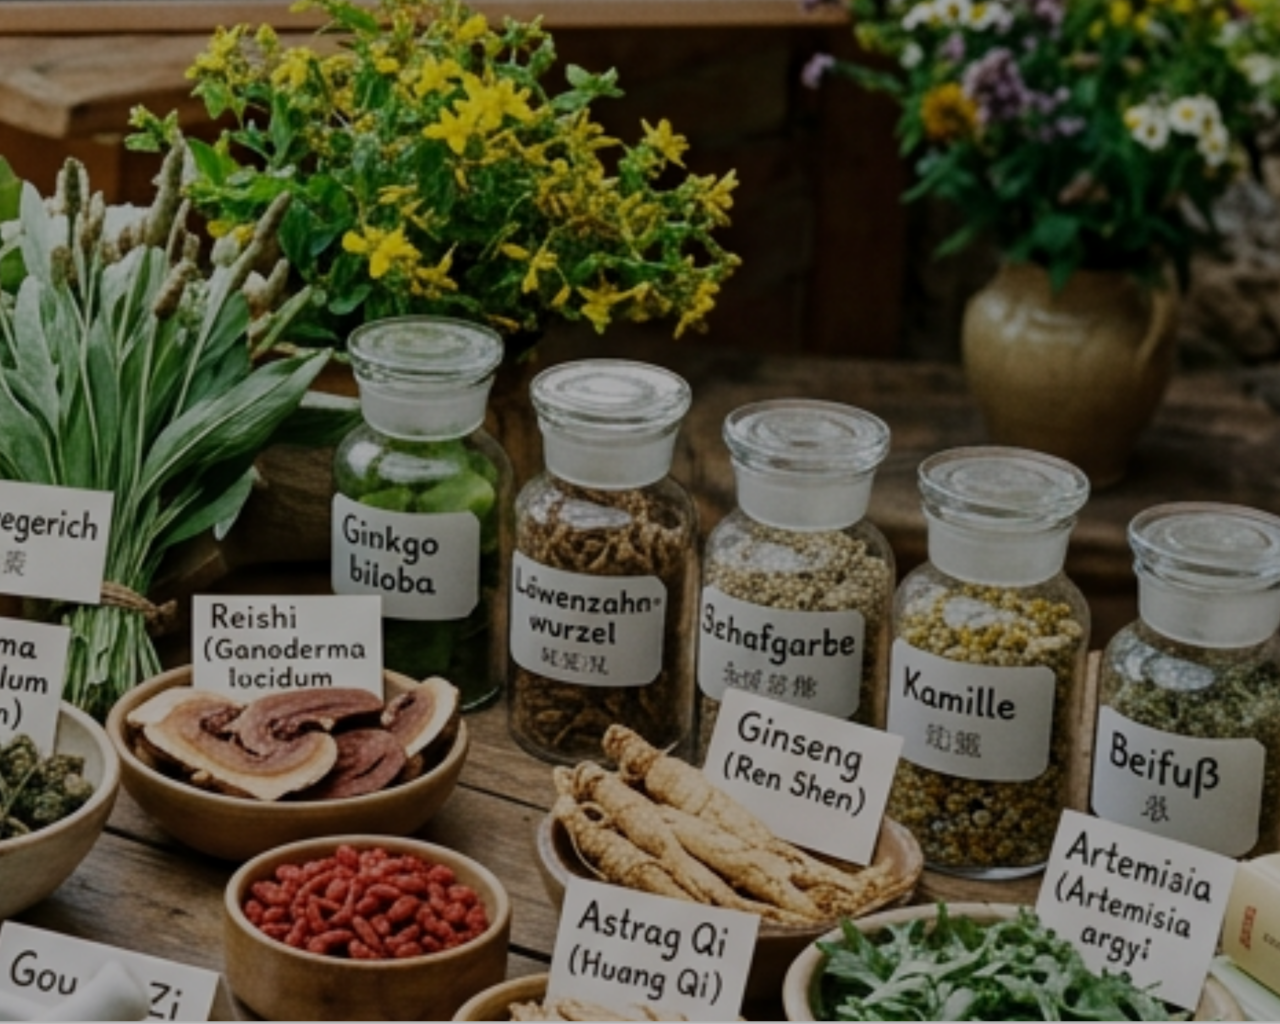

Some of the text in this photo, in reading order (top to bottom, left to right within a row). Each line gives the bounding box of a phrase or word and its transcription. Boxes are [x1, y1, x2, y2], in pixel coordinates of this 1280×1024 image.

[343, 513, 439, 566] Ginkgo
[350, 553, 436, 595] biloba
[212, 603, 296, 629] Reishi
[530, 618, 615, 645] wurzel
[204, 636, 365, 662] (Ganoderma
[903, 666, 1016, 720] Kamille
[737, 711, 862, 783] Ginseng
[1110, 731, 1219, 799] Beifuß
[723, 751, 866, 817] (Ren Shen)
[576, 900, 728, 962] Astrag Qi
[1055, 871, 1191, 938] (Artemisia
[10, 950, 77, 995] Gou
[568, 942, 722, 1005] (Huang Qi)
